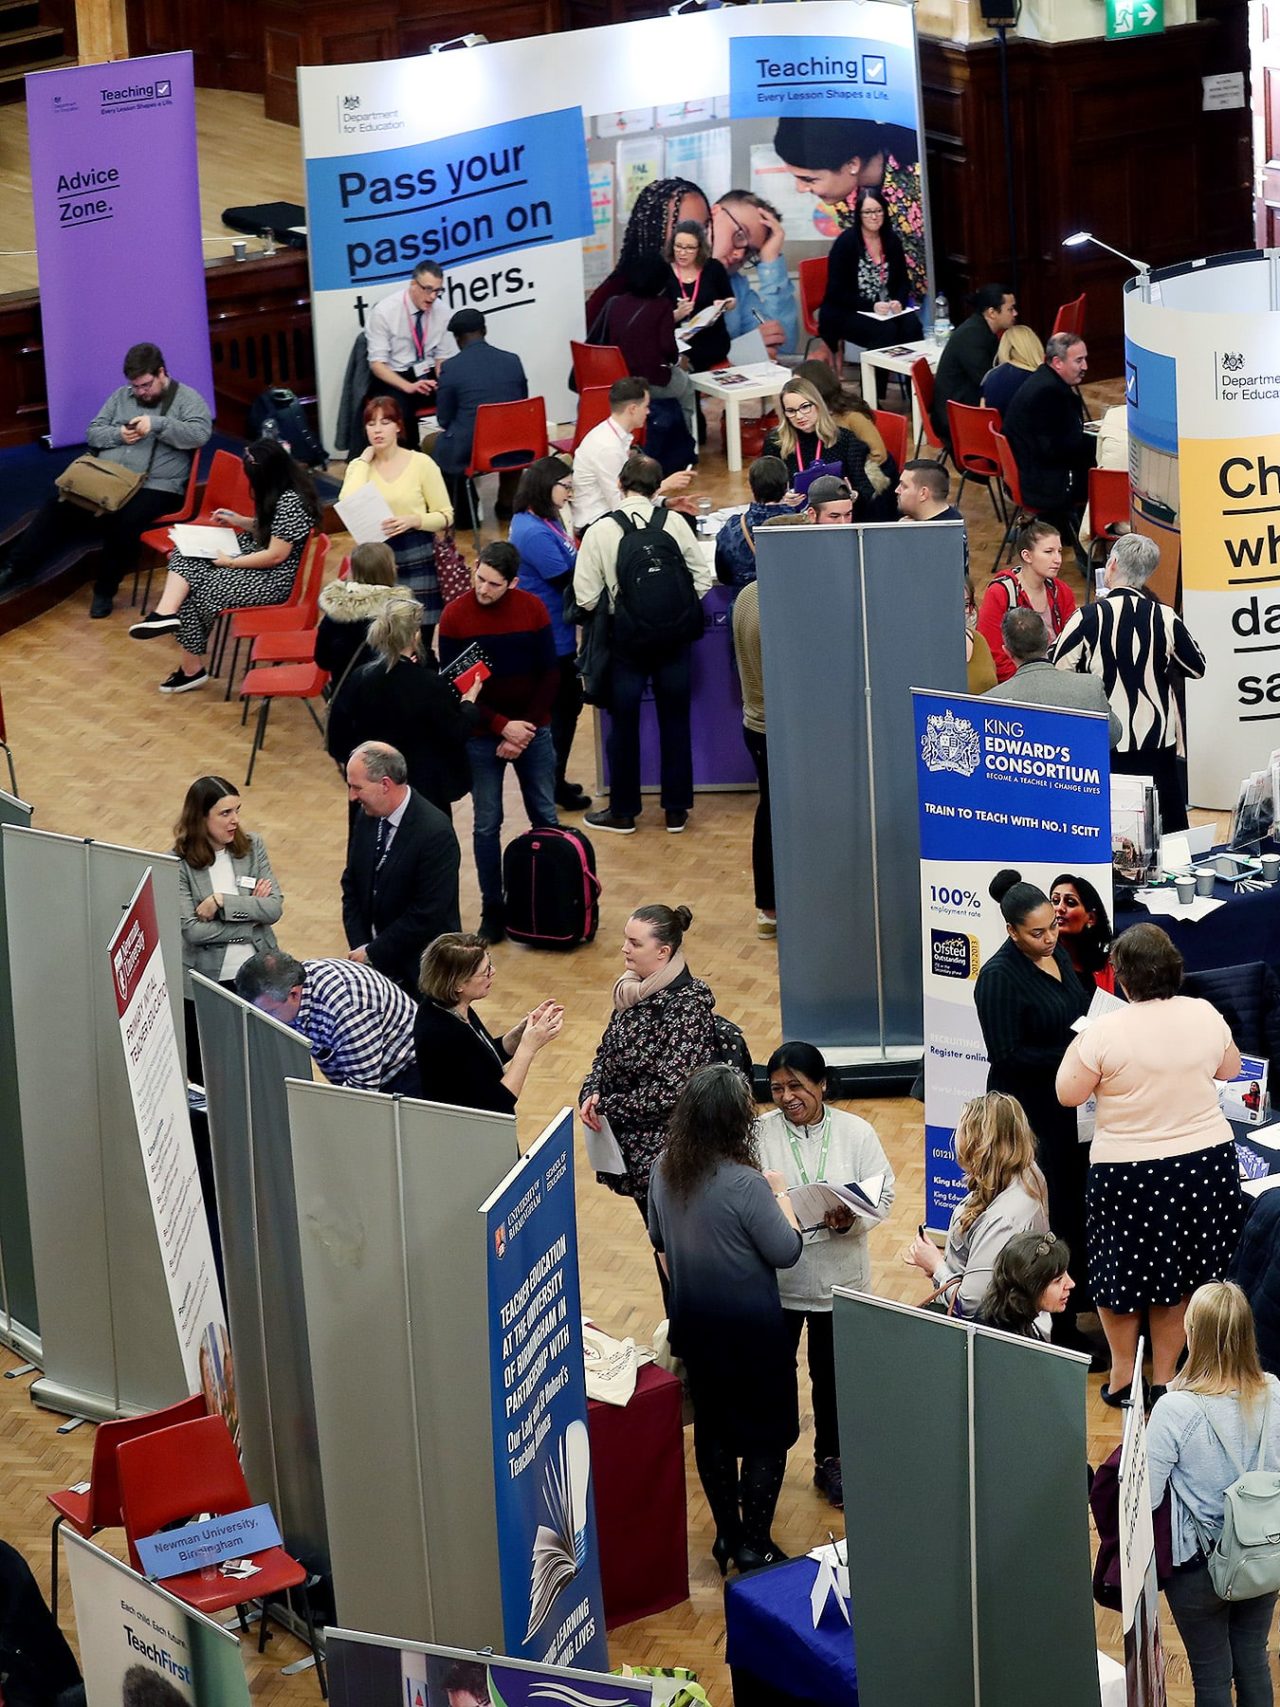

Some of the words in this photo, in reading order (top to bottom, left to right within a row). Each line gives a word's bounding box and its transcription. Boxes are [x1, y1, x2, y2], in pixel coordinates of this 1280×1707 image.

[756, 56, 858, 79] Teaching
[100, 85, 154, 101] Teaching
[757, 93, 785, 102] Every
[788, 91, 822, 100] Lesson
[826, 89, 863, 99] Shapes
[343, 110, 399, 123] Department
[343, 124, 357, 134] for
[359, 120, 405, 133] Education
[57, 168, 119, 193] Advice
[338, 167, 437, 208] Pass
[446, 145, 526, 195] your
[59, 200, 113, 221] Zone.
[346, 213, 494, 276] passion
[505, 199, 552, 233] on
[447, 267, 535, 309] hers.
[1222, 389, 1239, 401] for
[984, 718, 1025, 738] KING
[984, 736, 1071, 763] EDWARD'S
[984, 754, 1101, 785] CONSORTIUM
[986, 773, 1012, 782] BECOME
[1020, 777, 1048, 787] TEACHER
[1054, 782, 1082, 792] CHANGE
[1083, 787, 1101, 795] LIVES
[924, 802, 955, 817] TRAIN
[957, 807, 973, 819] TO
[975, 810, 1008, 825] TEACH
[1011, 816, 1039, 829] WITH
[1041, 820, 1068, 834] NO.1
[1071, 824, 1100, 838] SCITT
[930, 885, 981, 909] 100%
[930, 905, 967, 918] employment
[968, 910, 981, 918] rate
[933, 942, 966, 957] Ofsted
[933, 954, 966, 966] Outstanding
[930, 1045, 963, 1058] Register
[965, 1053, 987, 1062] onlin
[932, 1148, 955, 1161] (0121)
[933, 1176, 951, 1188] King
[951, 1179, 968, 1189] Edw
[933, 1190, 947, 1201] King
[500, 1278, 530, 1330] TEACHER
[529, 1233, 567, 1293] EDUCATION
[502, 1331, 513, 1361] AT
[513, 1315, 528, 1347] THE
[526, 1267, 563, 1330] UNIVERSITY
[503, 1360, 516, 1389] OF
[516, 1306, 558, 1377] BIRMINGHAM
[557, 1295, 567, 1322] IN
[505, 1345, 549, 1418] PARTNERSHIP
[549, 1324, 570, 1361] WITH
[507, 1428, 521, 1454] Our
[154, 1533, 201, 1554] Newman
[202, 1517, 259, 1540] University,
[178, 1537, 244, 1562] Birmingham
[121, 1600, 136, 1615] Each
[152, 1620, 167, 1637] Each
[556, 1597, 590, 1651] LEARNING
[574, 1617, 595, 1654] LIVES
[123, 1624, 192, 1685] TeachFirst
